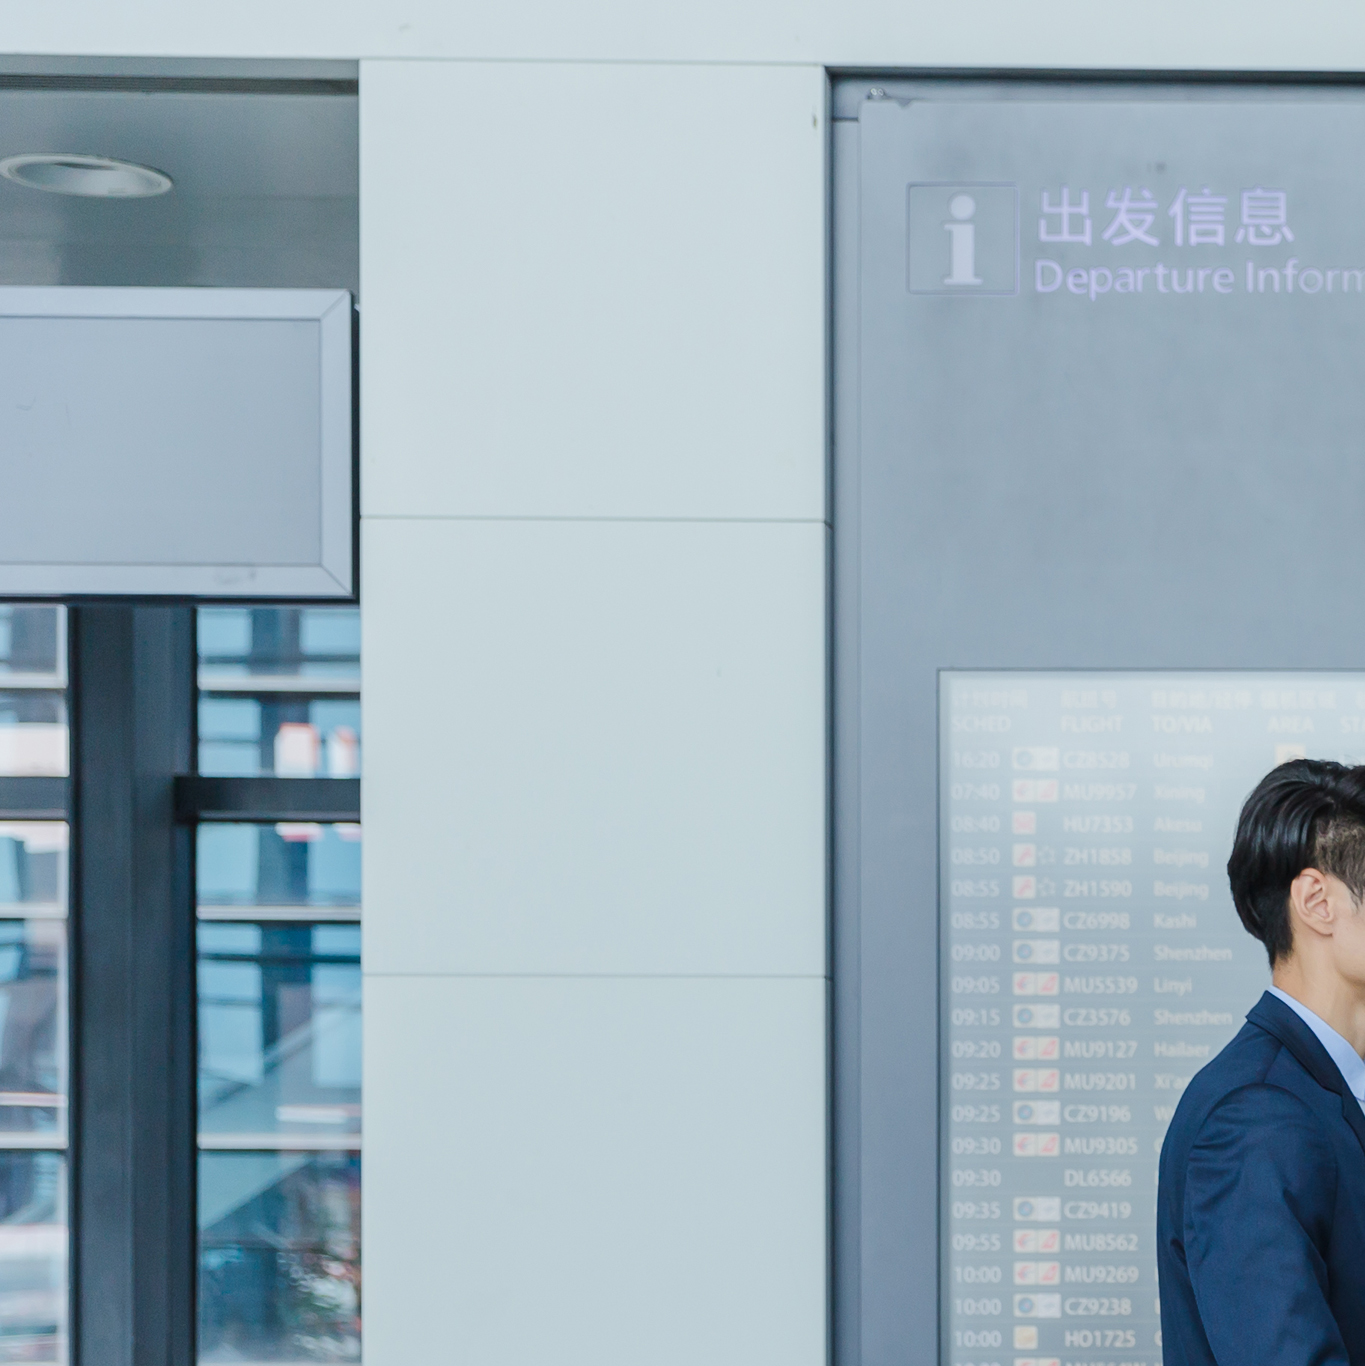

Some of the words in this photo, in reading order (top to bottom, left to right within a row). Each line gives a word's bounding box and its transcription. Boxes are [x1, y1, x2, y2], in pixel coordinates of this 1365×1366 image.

[1037, 185, 1295, 248] 出发信息
[1035, 259, 1235, 300] Departure
